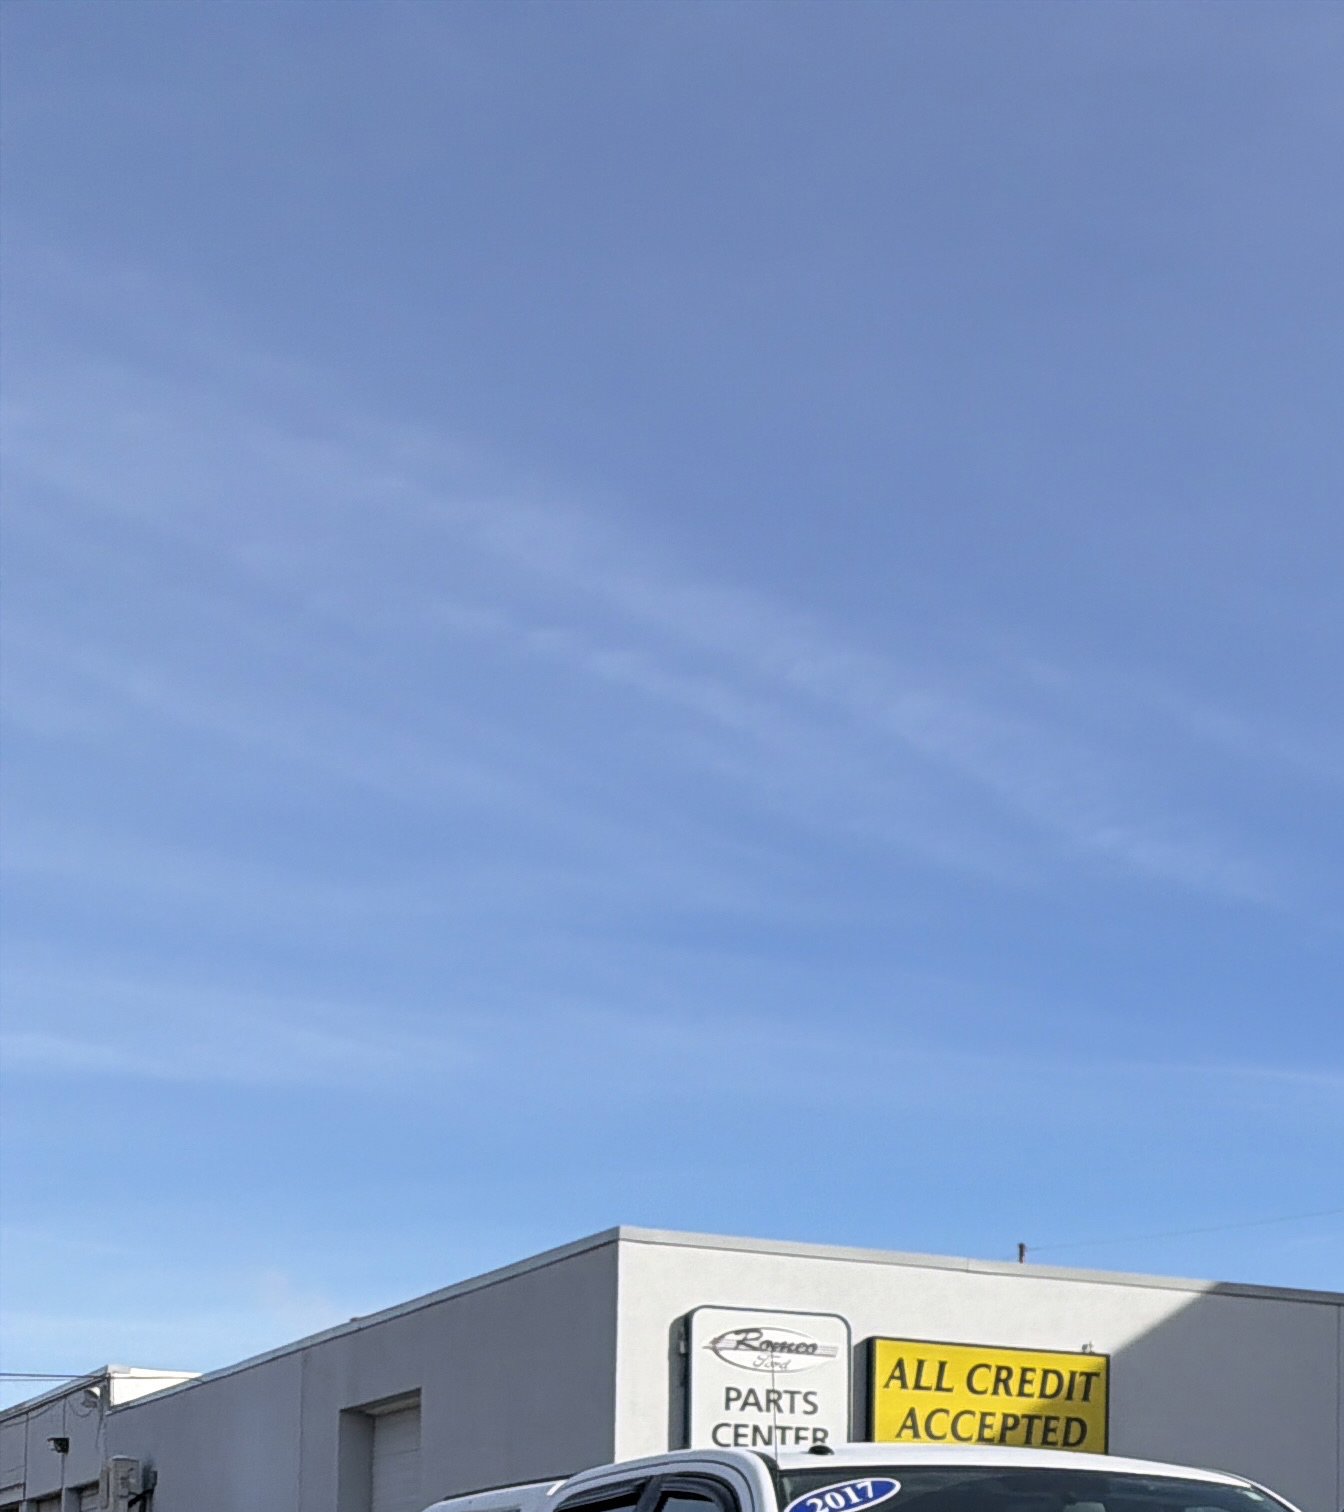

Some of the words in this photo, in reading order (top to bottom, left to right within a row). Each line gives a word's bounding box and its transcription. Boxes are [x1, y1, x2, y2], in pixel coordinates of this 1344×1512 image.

[733, 1327, 818, 1354] Romeo
[752, 1354, 791, 1369] Ford
[883, 1356, 953, 1393] ALL
[966, 1362, 1100, 1402] CREDIT
[724, 1386, 819, 1415] PARTS
[711, 1422, 829, 1447] CENTER
[895, 1406, 1088, 1448] ACCEPTED
